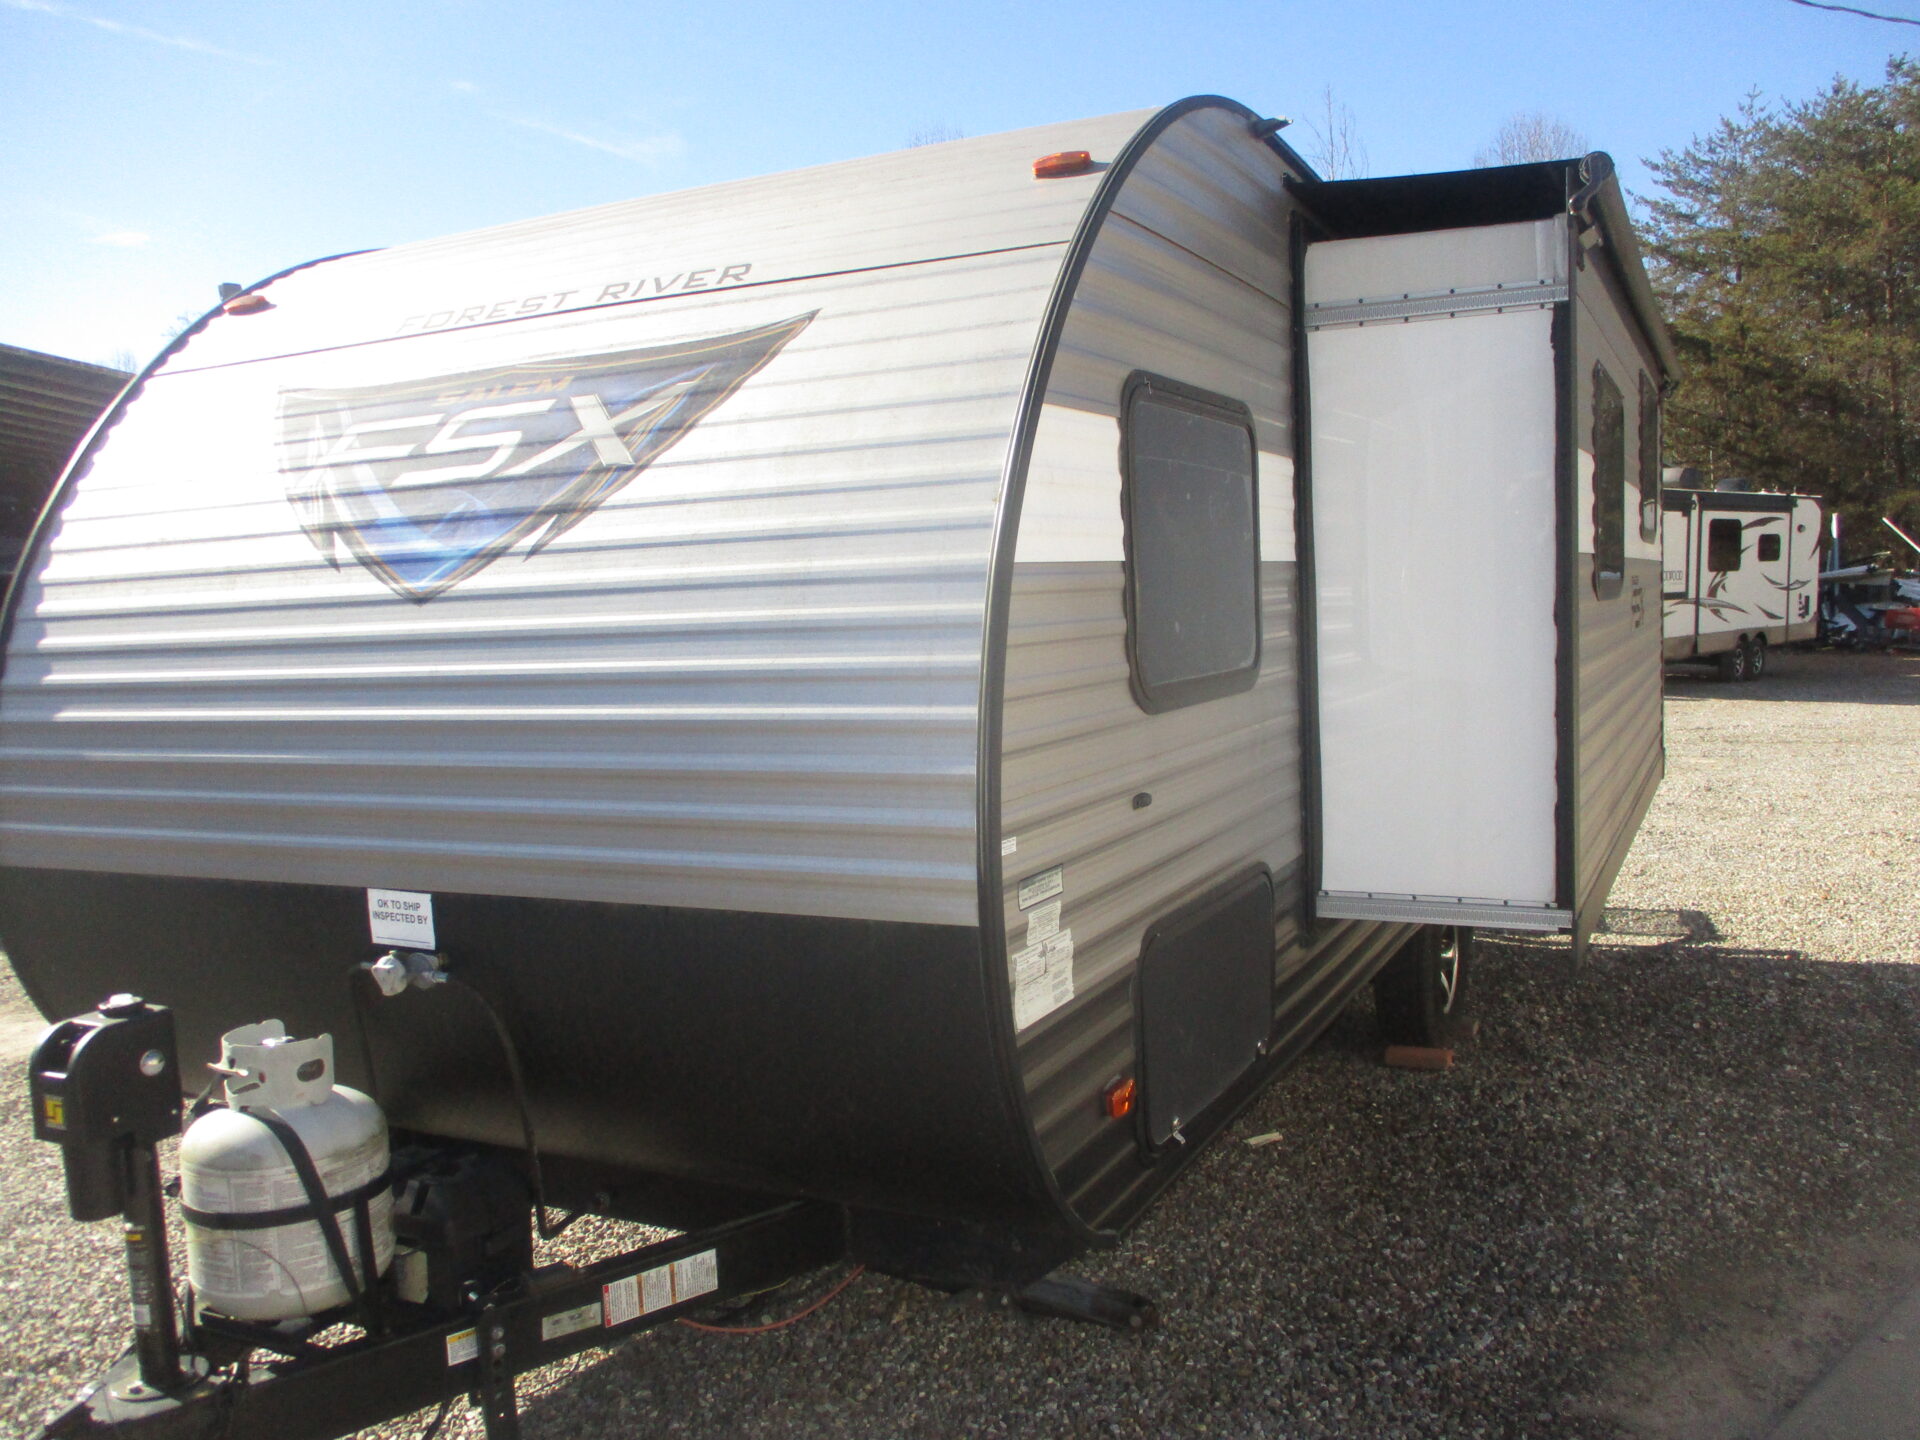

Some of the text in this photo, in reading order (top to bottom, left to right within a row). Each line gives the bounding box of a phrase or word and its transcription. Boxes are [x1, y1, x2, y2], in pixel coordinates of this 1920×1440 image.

[398, 263, 752, 332] FOREST RIVER
[434, 376, 575, 405] SALEM
[377, 898, 421, 912] OK TO SHIP
[372, 910, 428, 925] INSPECTED BY
